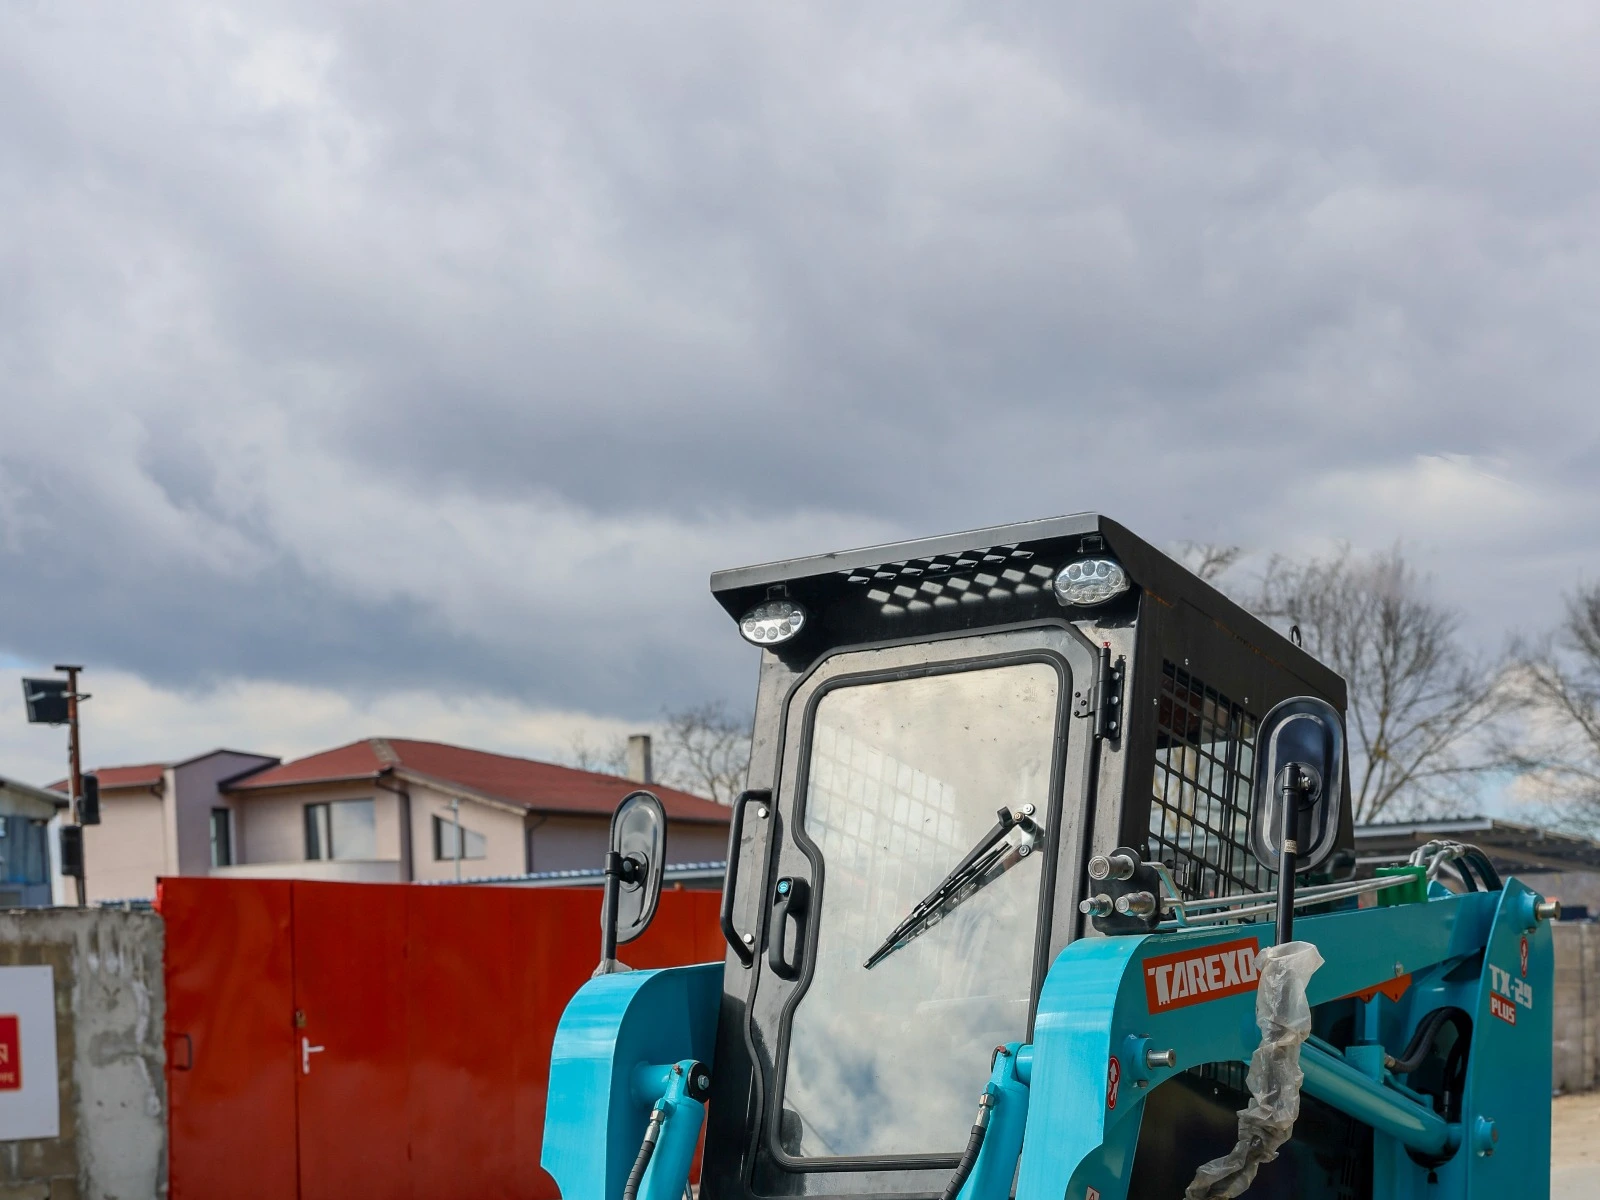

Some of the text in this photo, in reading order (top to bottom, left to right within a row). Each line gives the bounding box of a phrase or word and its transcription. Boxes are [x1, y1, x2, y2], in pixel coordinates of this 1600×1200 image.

[1147, 946, 1259, 1007] TAREXO
[1488, 963, 1533, 1010] TX-29
[1491, 996, 1516, 1025] PLUS
